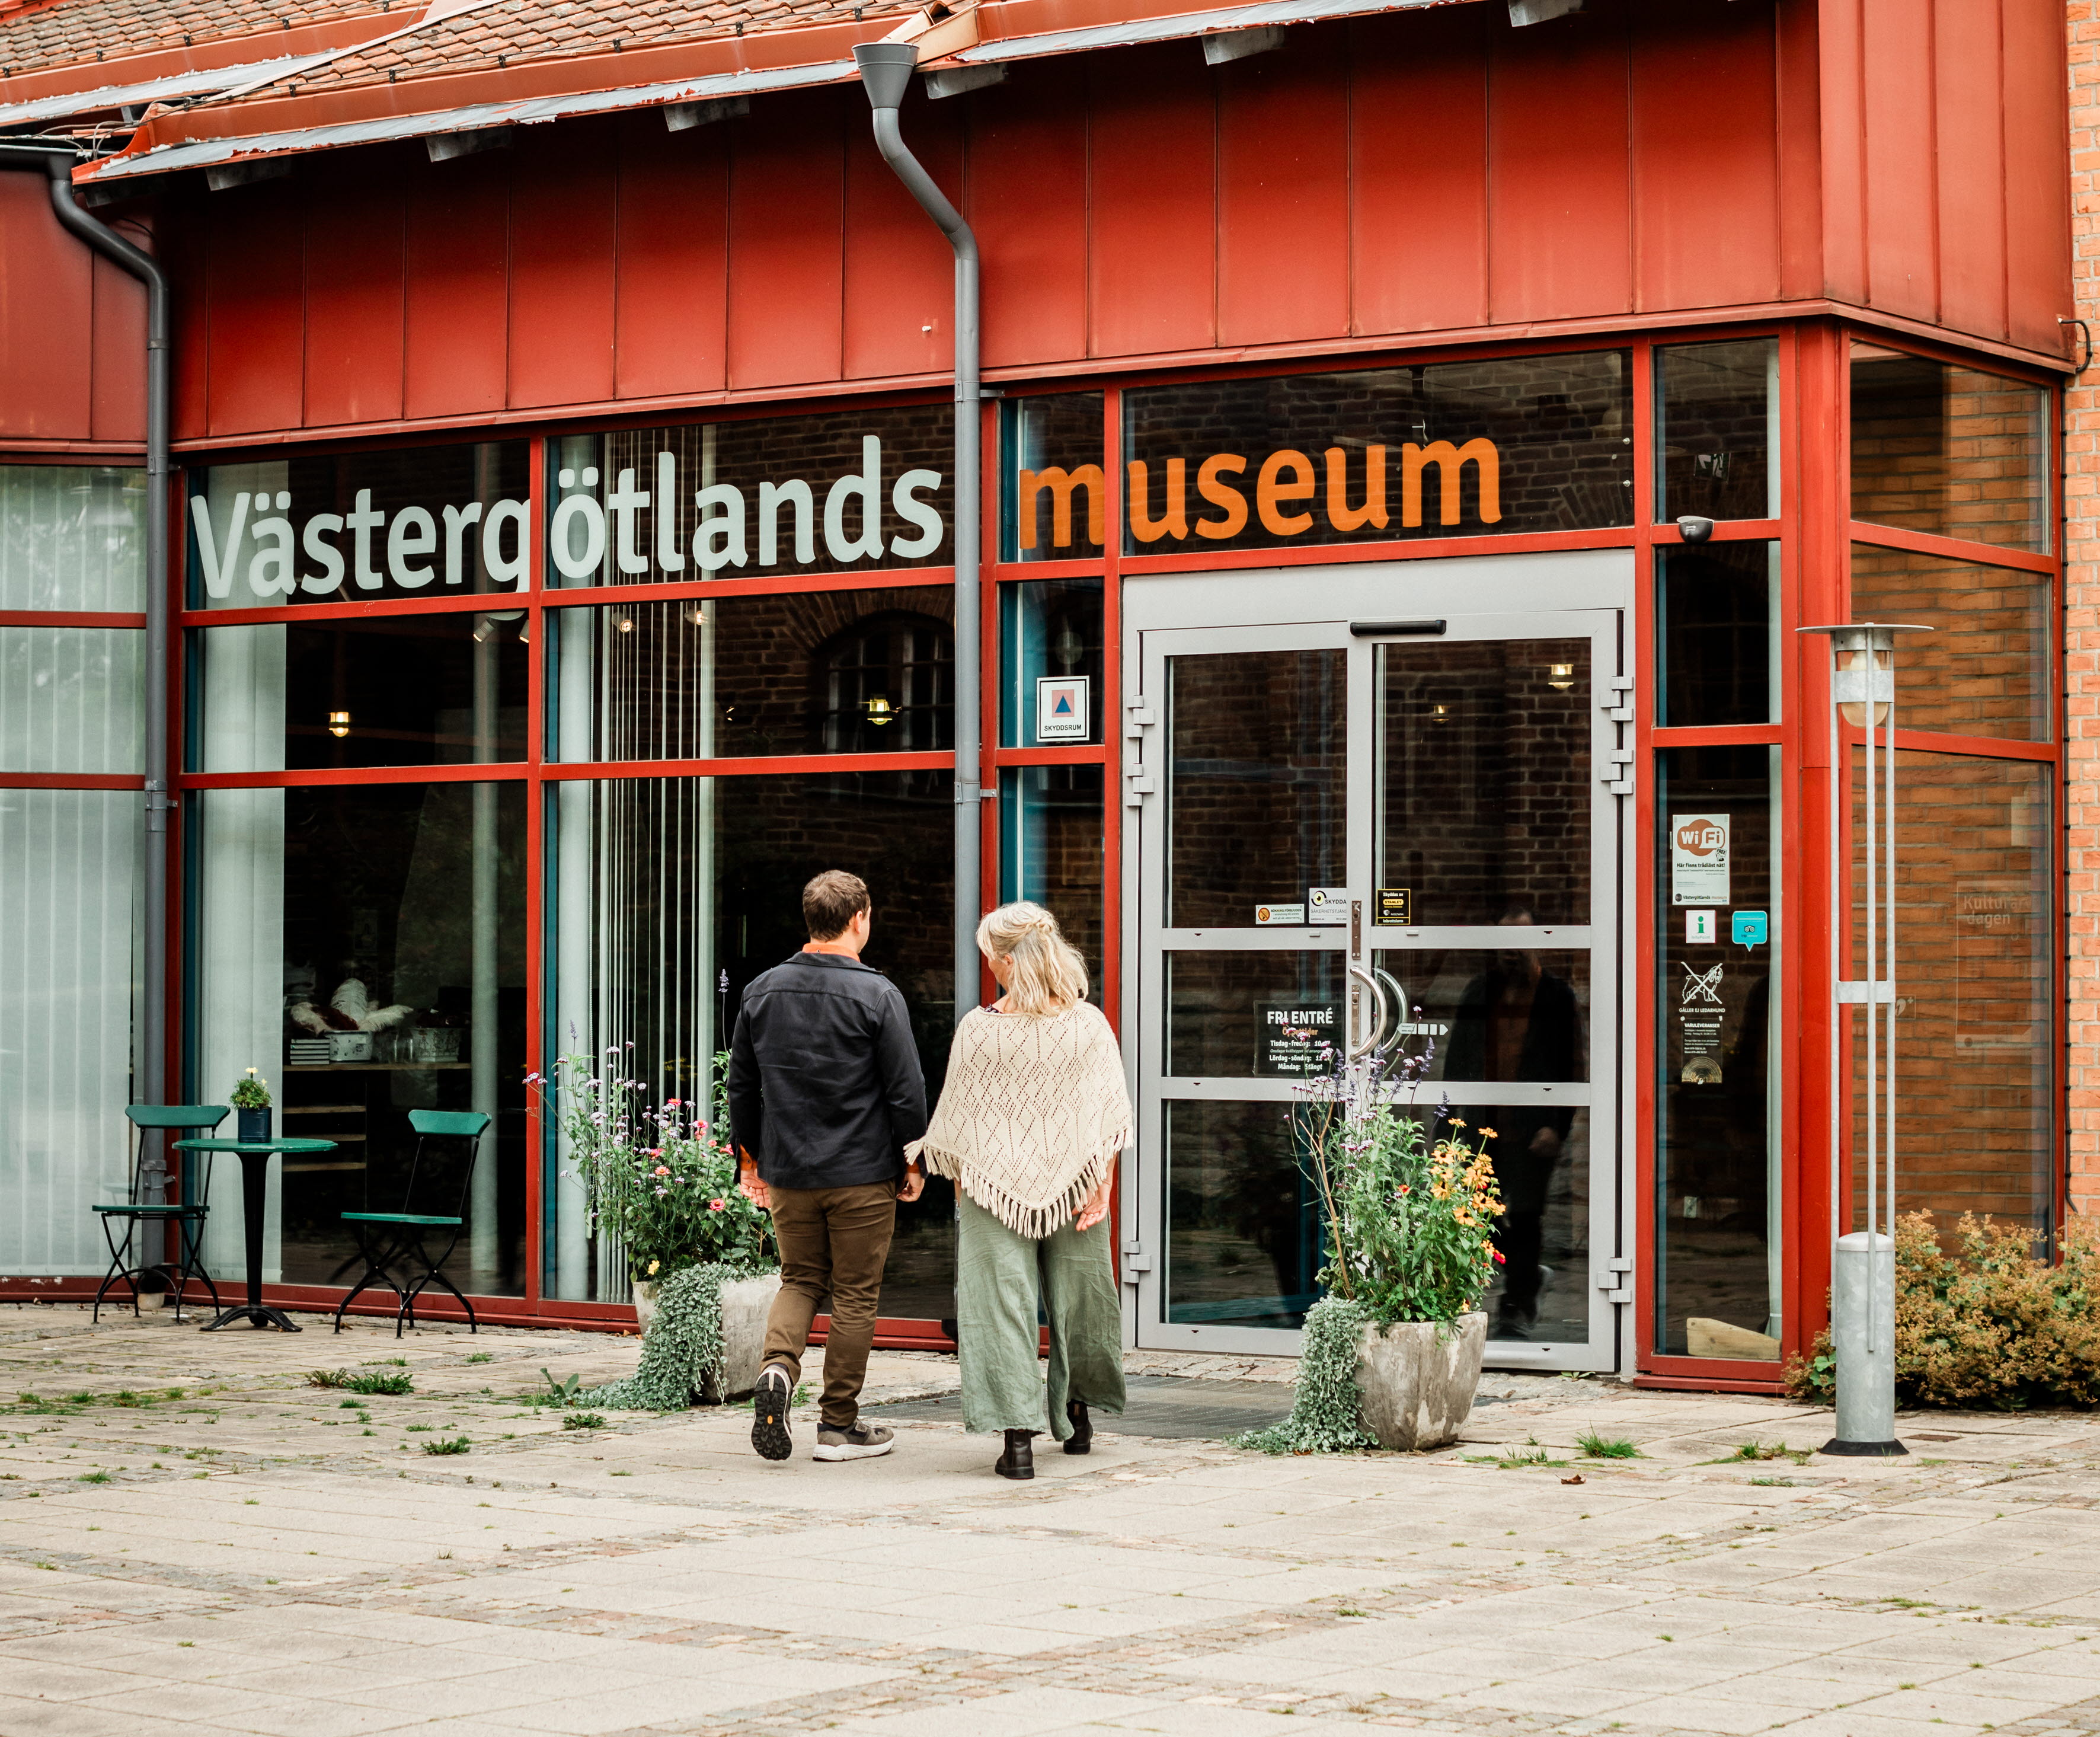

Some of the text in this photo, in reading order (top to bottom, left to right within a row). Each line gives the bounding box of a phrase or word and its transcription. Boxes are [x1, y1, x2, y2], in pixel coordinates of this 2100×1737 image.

[190, 433, 1502, 599] Västergötlands museum
[1267, 1007, 1334, 1024] FRI ENTRÉ
[1277, 1062, 1323, 1071] Måndag: Stängt
